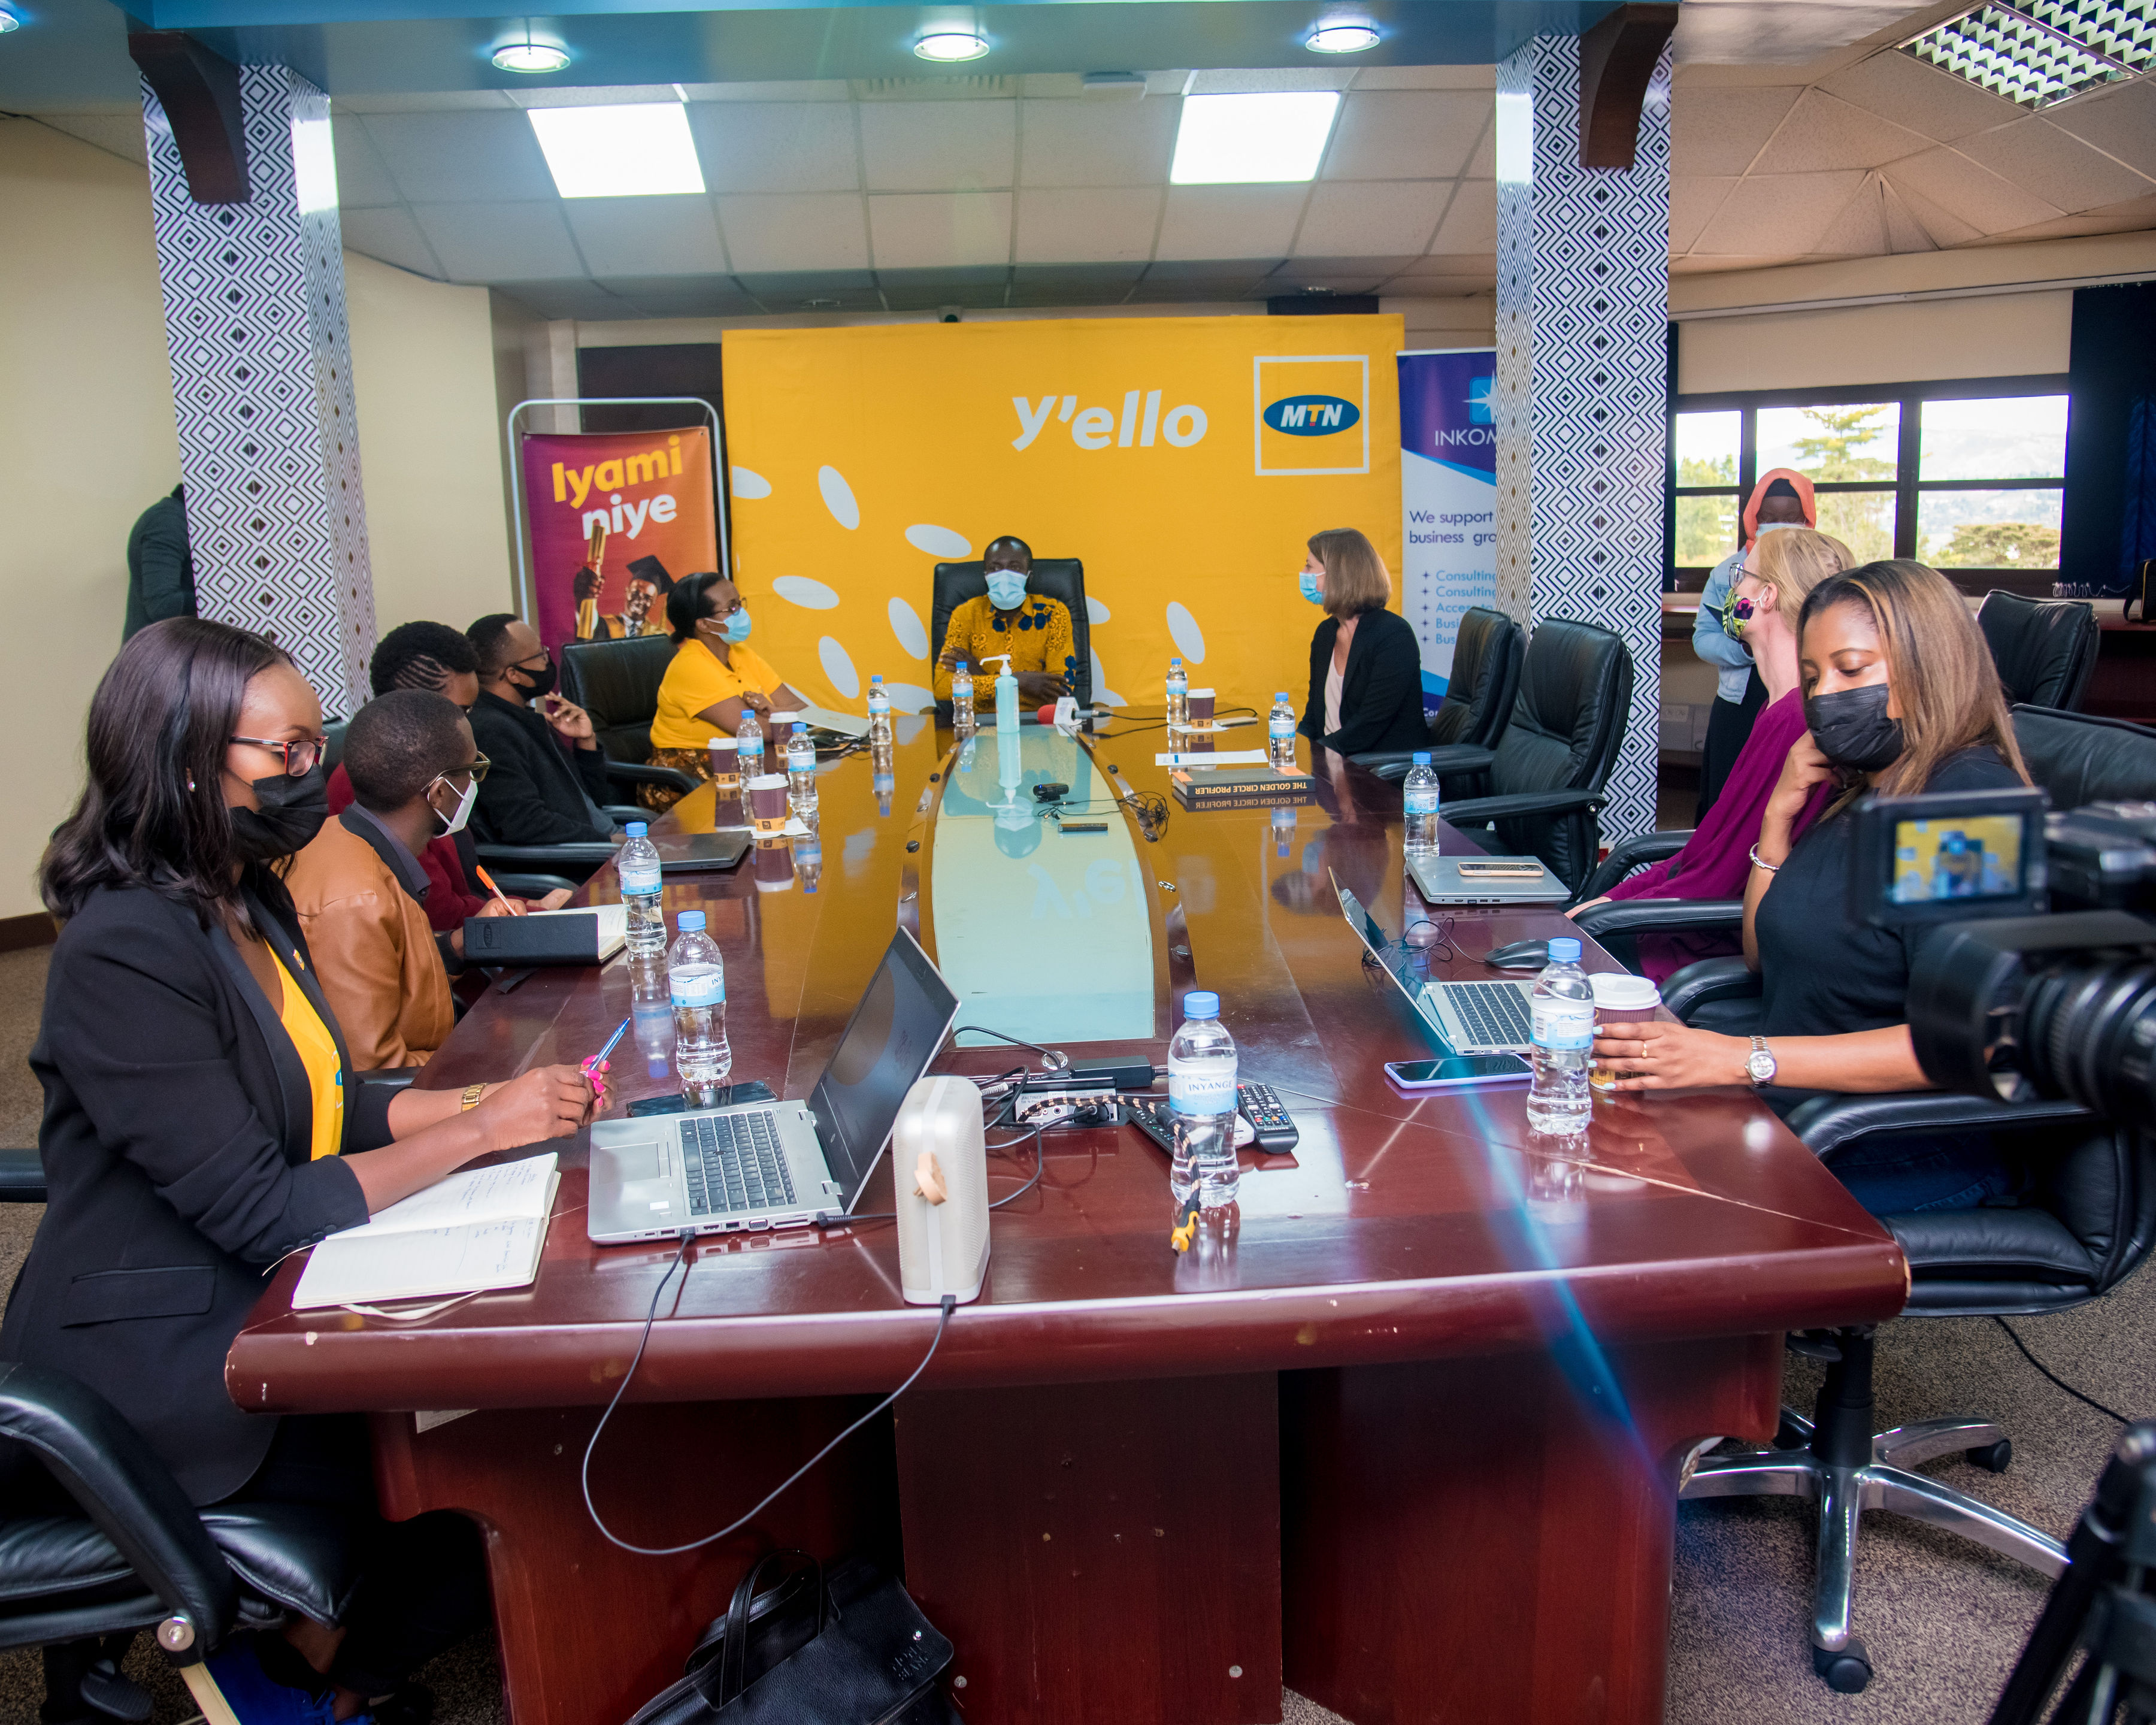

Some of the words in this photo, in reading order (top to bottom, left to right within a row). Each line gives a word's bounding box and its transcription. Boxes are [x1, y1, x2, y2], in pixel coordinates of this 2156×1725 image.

[1012, 389, 1208, 452] y'ello
[1280, 404, 1343, 427] MTN
[552, 435, 683, 509] Iyami
[582, 494, 677, 540] niye
[1409, 510, 1435, 523] We
[1440, 512, 1493, 526] support
[1409, 530, 1464, 544] business
[1436, 570, 1496, 583] Consulting
[1436, 586, 1496, 600] Consulting
[1436, 602, 1471, 613] Acce
[1195, 785, 1231, 795] PROFILER
[1233, 785, 1258, 793] CIRCLE
[1260, 783, 1291, 791] GOLDEN
[1189, 1080, 1233, 1091] INYANGE
